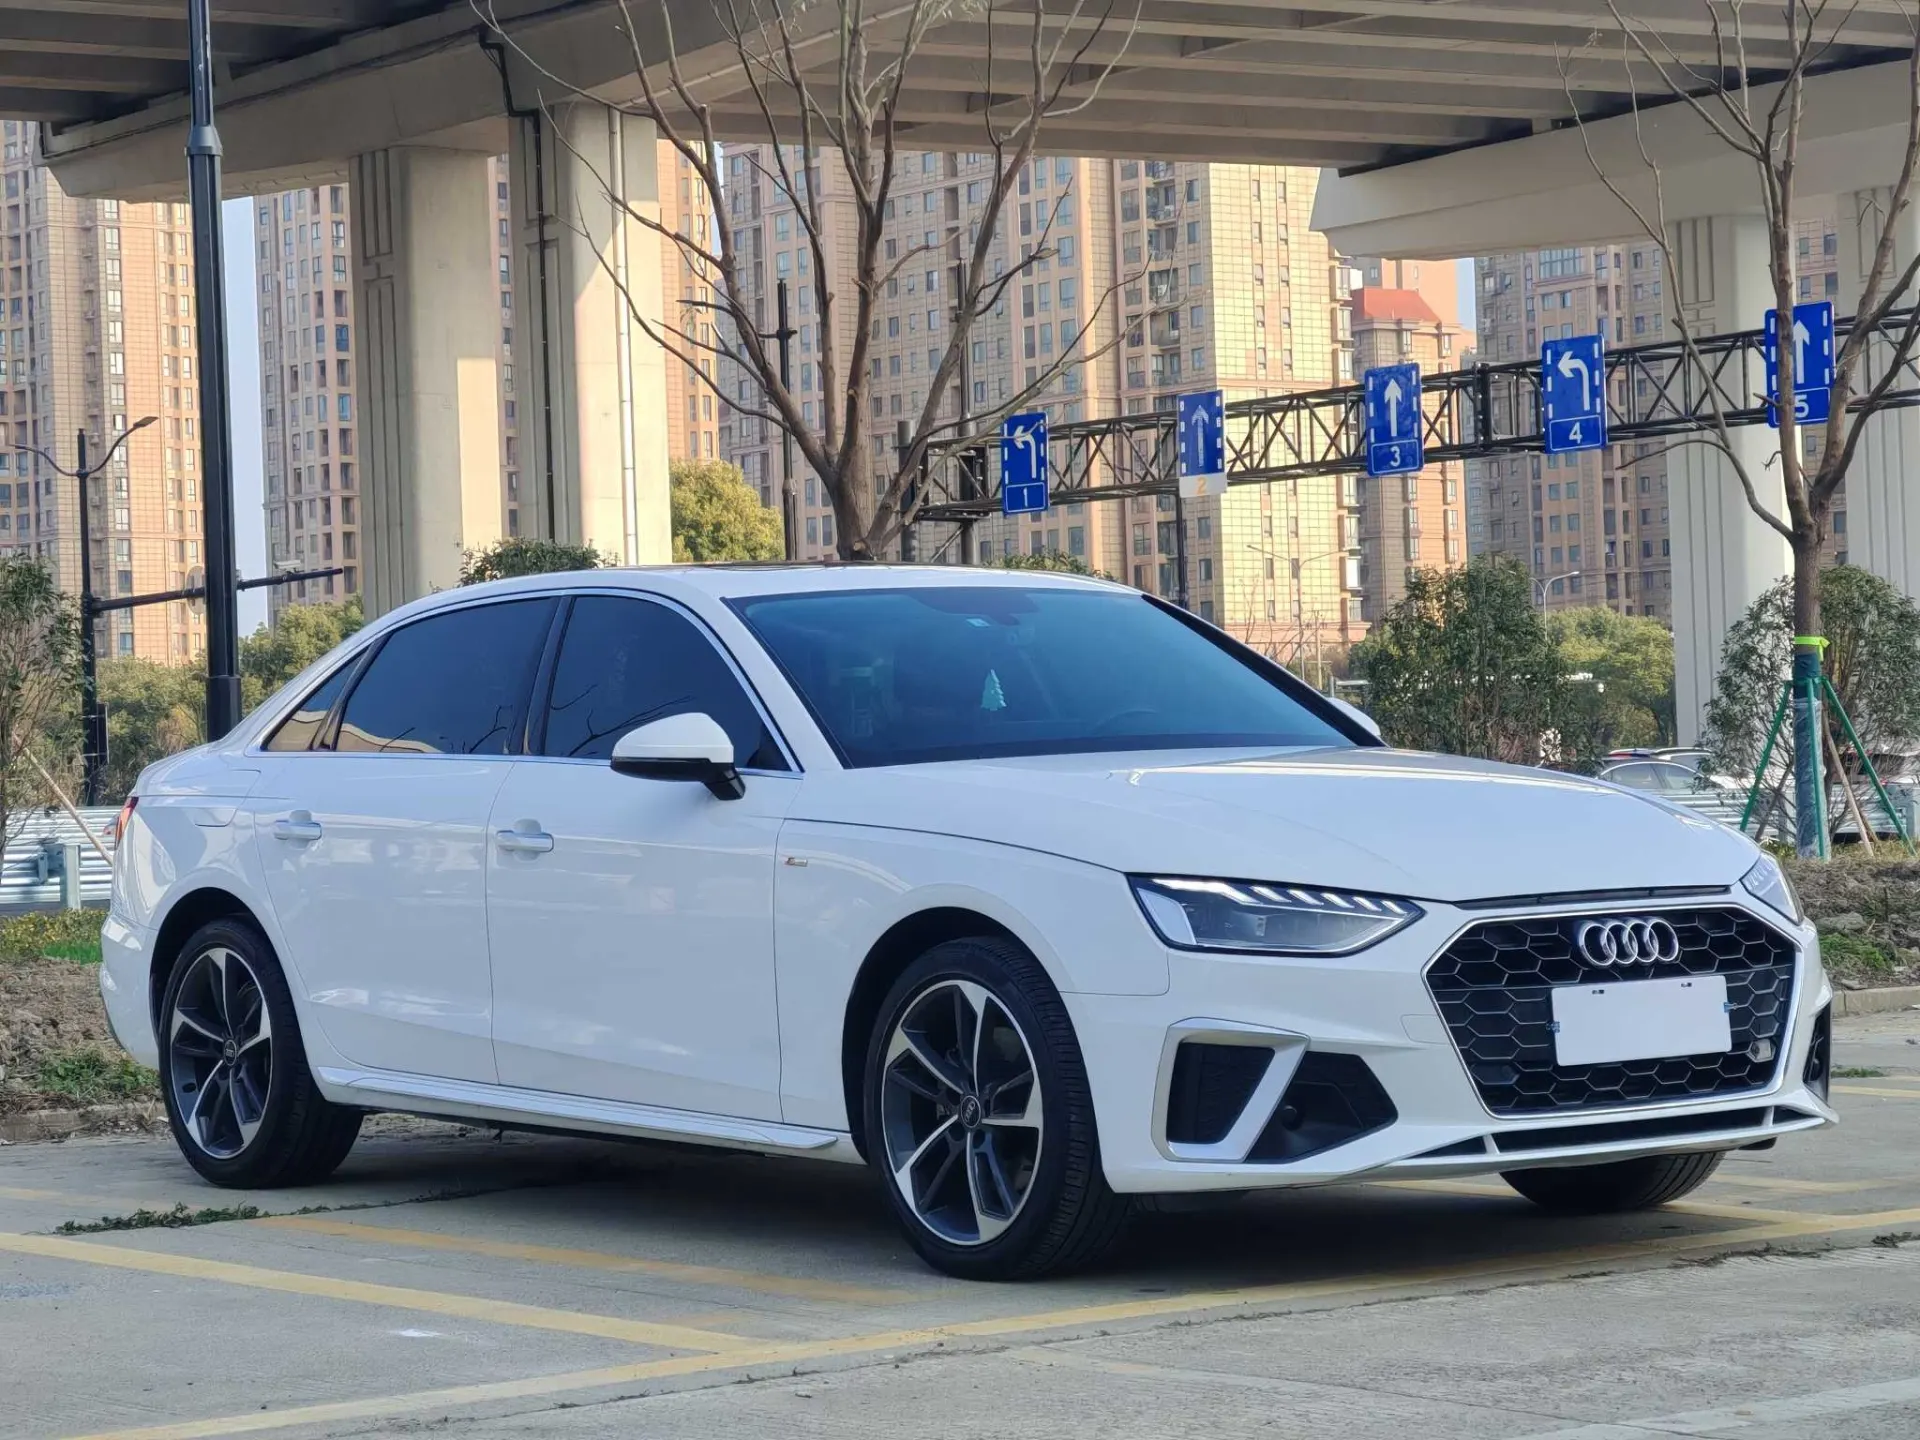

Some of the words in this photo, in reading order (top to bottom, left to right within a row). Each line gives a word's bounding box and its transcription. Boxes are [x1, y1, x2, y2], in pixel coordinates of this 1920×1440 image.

[1793, 394, 1809, 418] 5
[1568, 421, 1583, 444] 4
[1390, 445, 1400, 467] 3
[1195, 476, 1207, 497] 2
